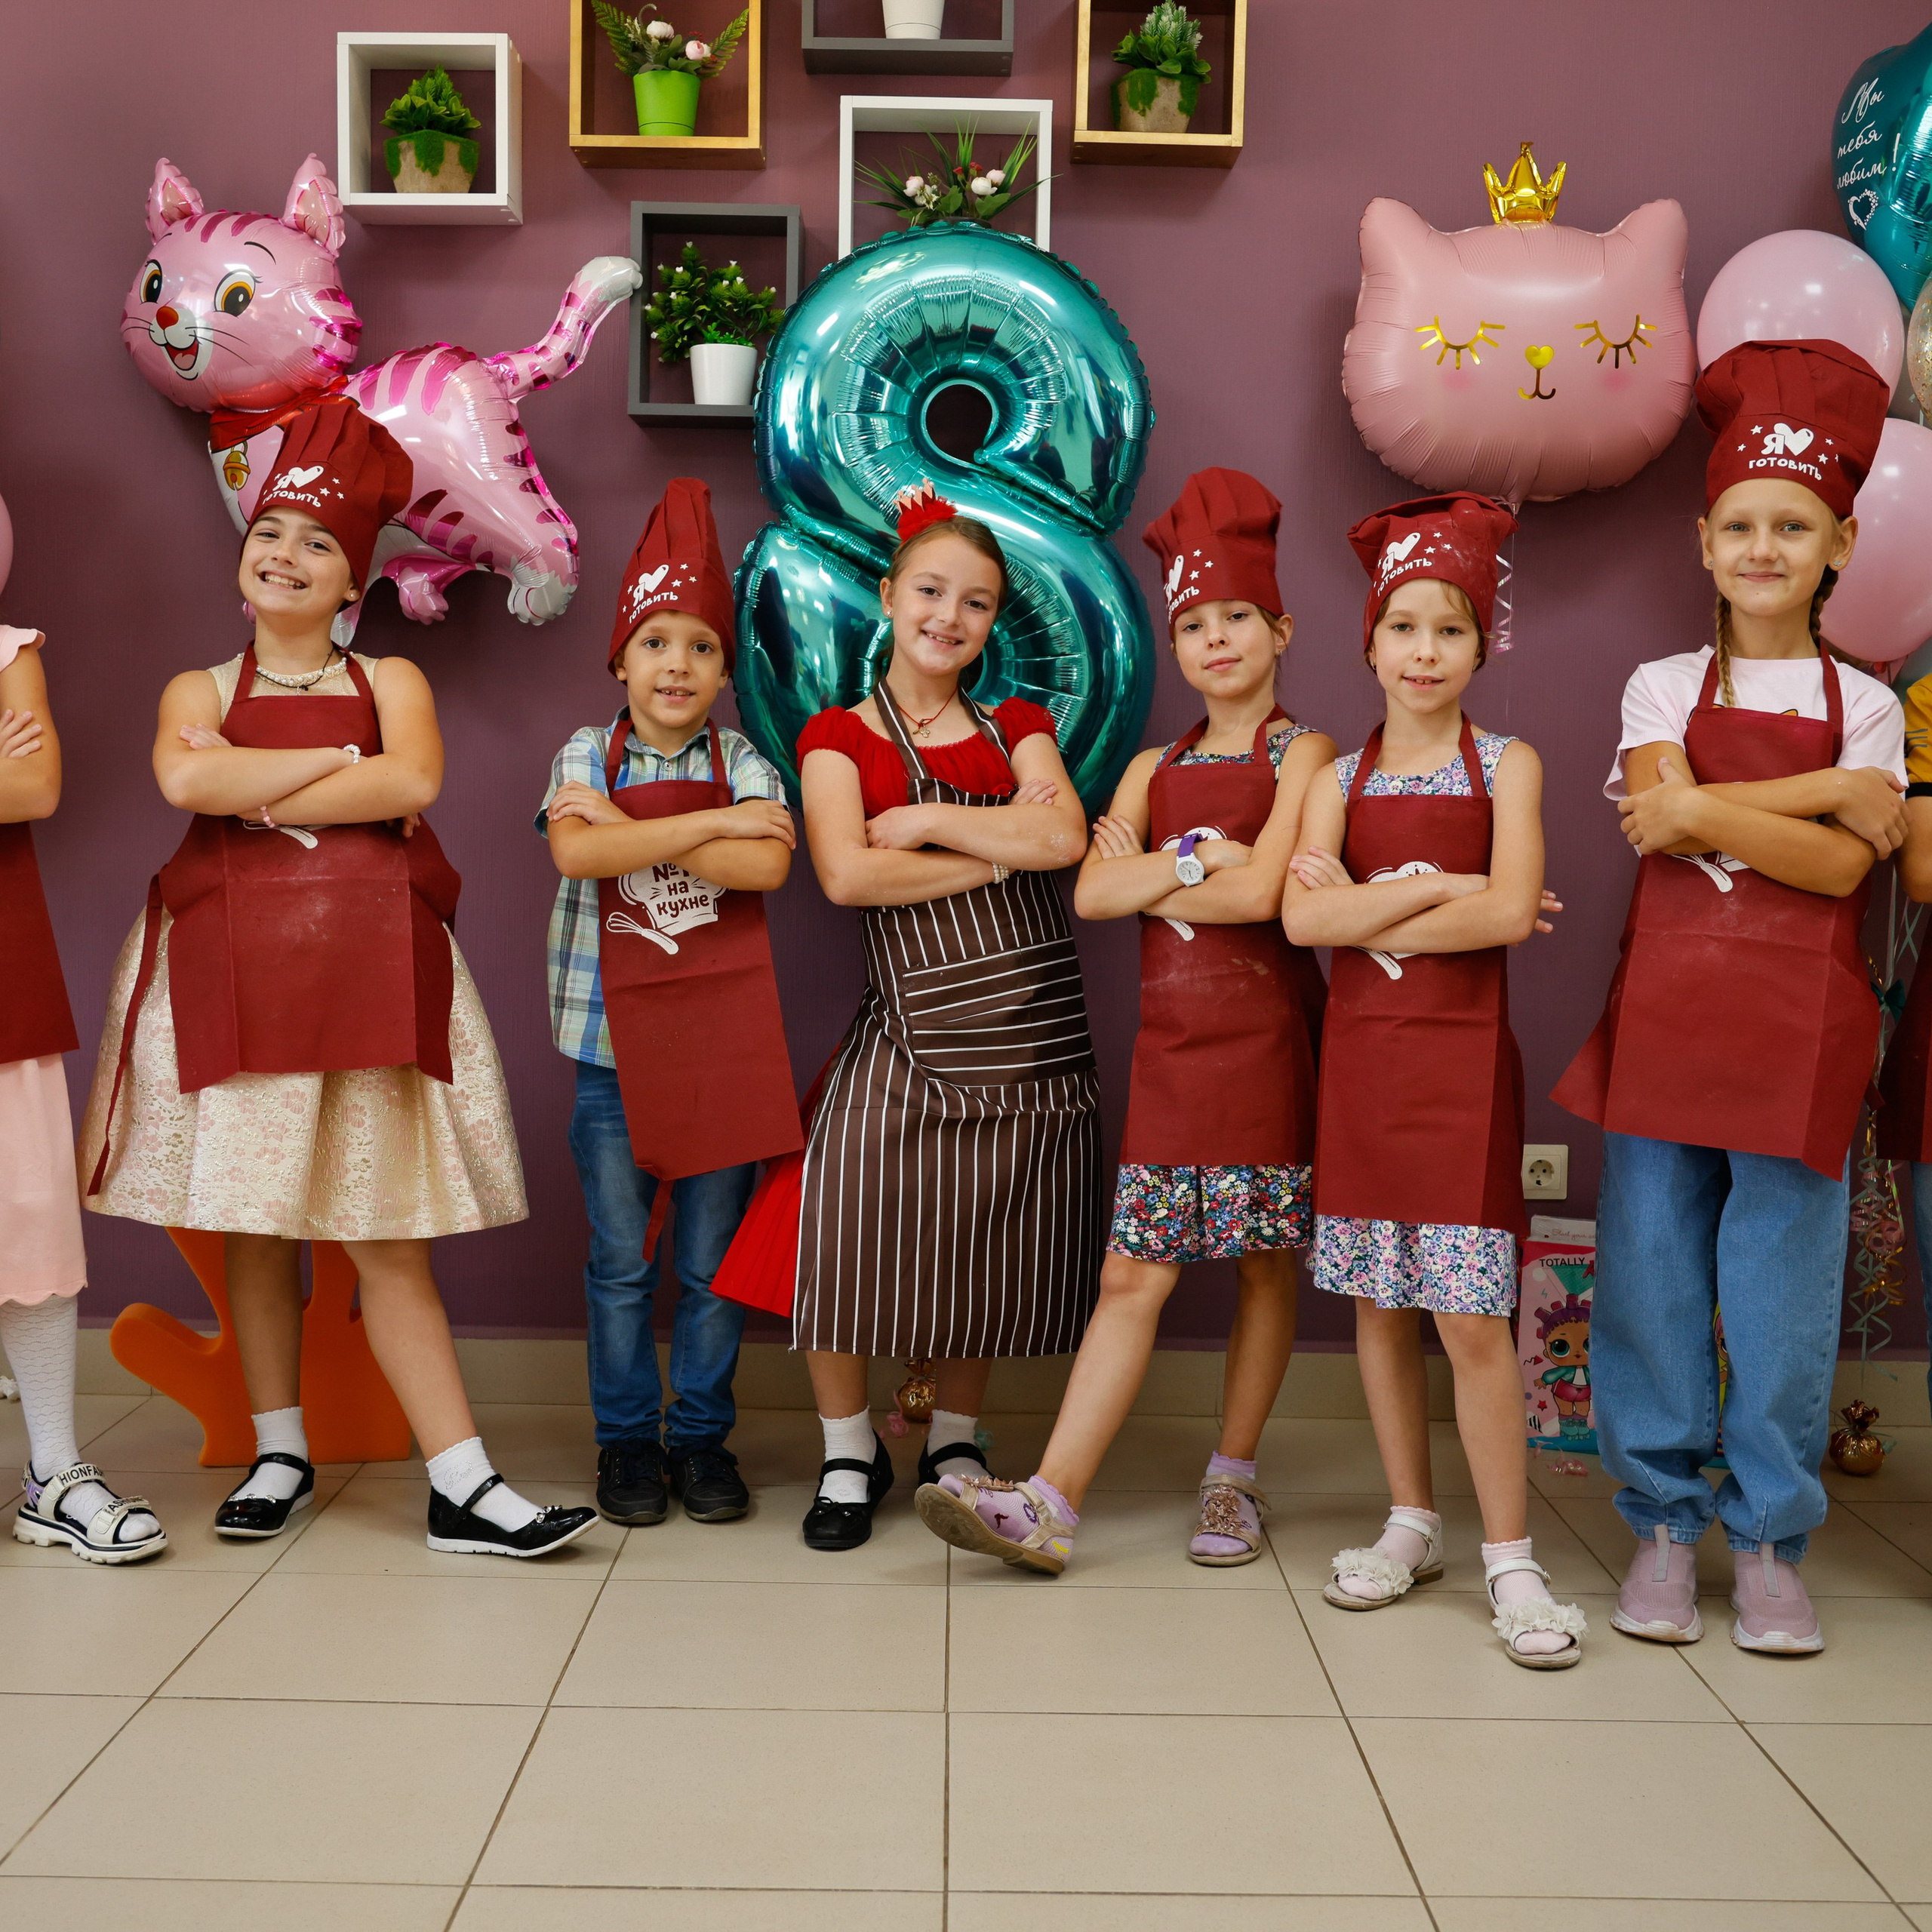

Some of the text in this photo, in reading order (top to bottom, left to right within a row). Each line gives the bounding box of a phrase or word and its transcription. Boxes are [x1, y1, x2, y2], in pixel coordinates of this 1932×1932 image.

[1837, 121, 1883, 159] тебя
[1761, 433, 1785, 455] Я
[272, 475, 295, 491] Я
[1381, 552, 1395, 579] Я
[632, 582, 645, 607] Я
[667, 881, 689, 897] на
[656, 894, 710, 918] кухне
[1540, 1257, 1585, 1268] TOTALLY
